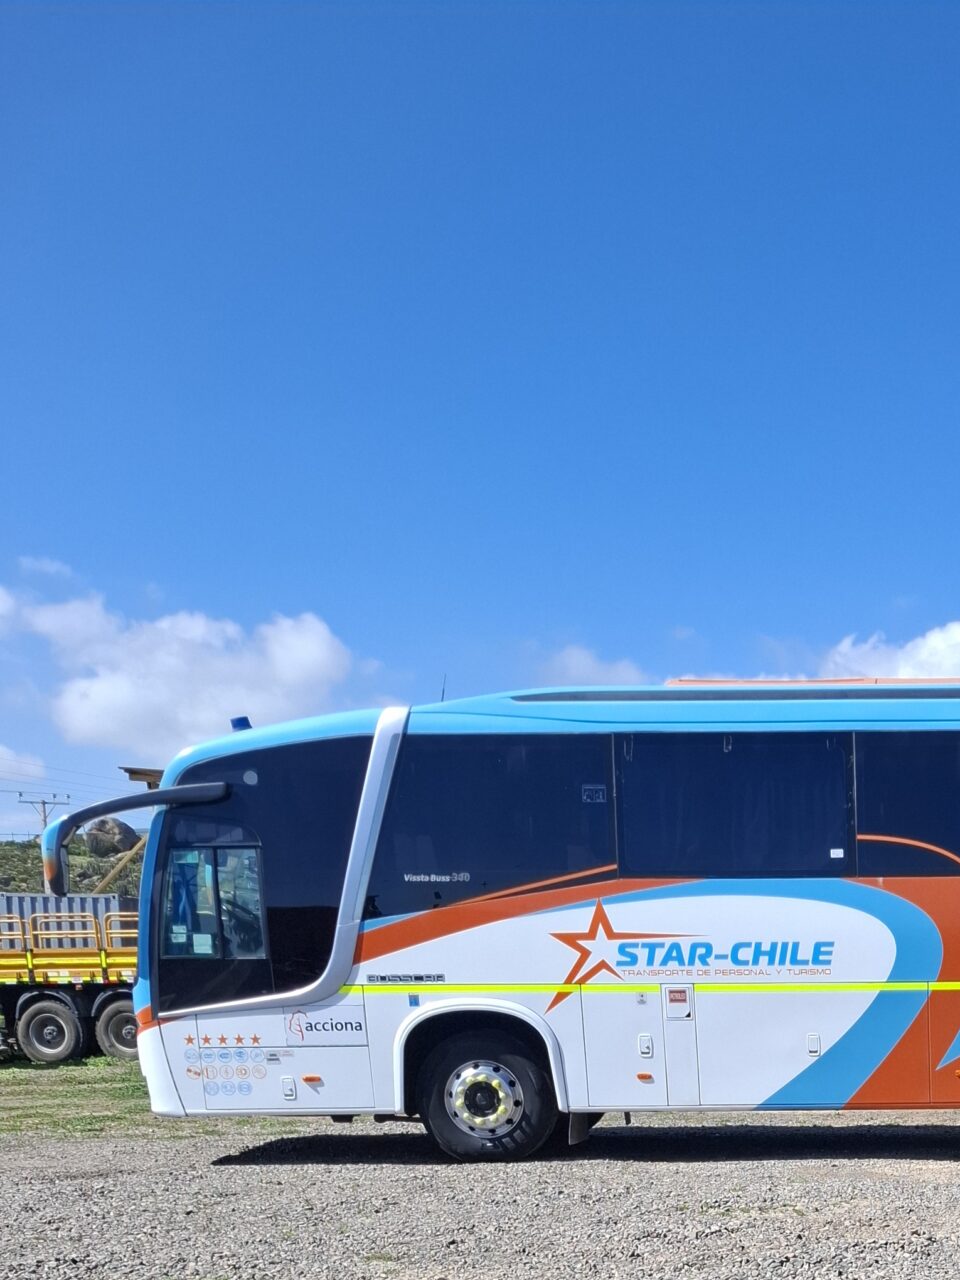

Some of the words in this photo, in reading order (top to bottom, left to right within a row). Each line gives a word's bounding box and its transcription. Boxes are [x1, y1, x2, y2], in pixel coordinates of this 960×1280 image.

[616, 941, 835, 967] STAR-CHILE
[621, 969, 693, 977] TRANSPORTE
[714, 968, 771, 976] PERSONAL
[775, 968, 783, 976] Y
[786, 968, 832, 976] TURISMO
[305, 1017, 363, 1032] acciona
